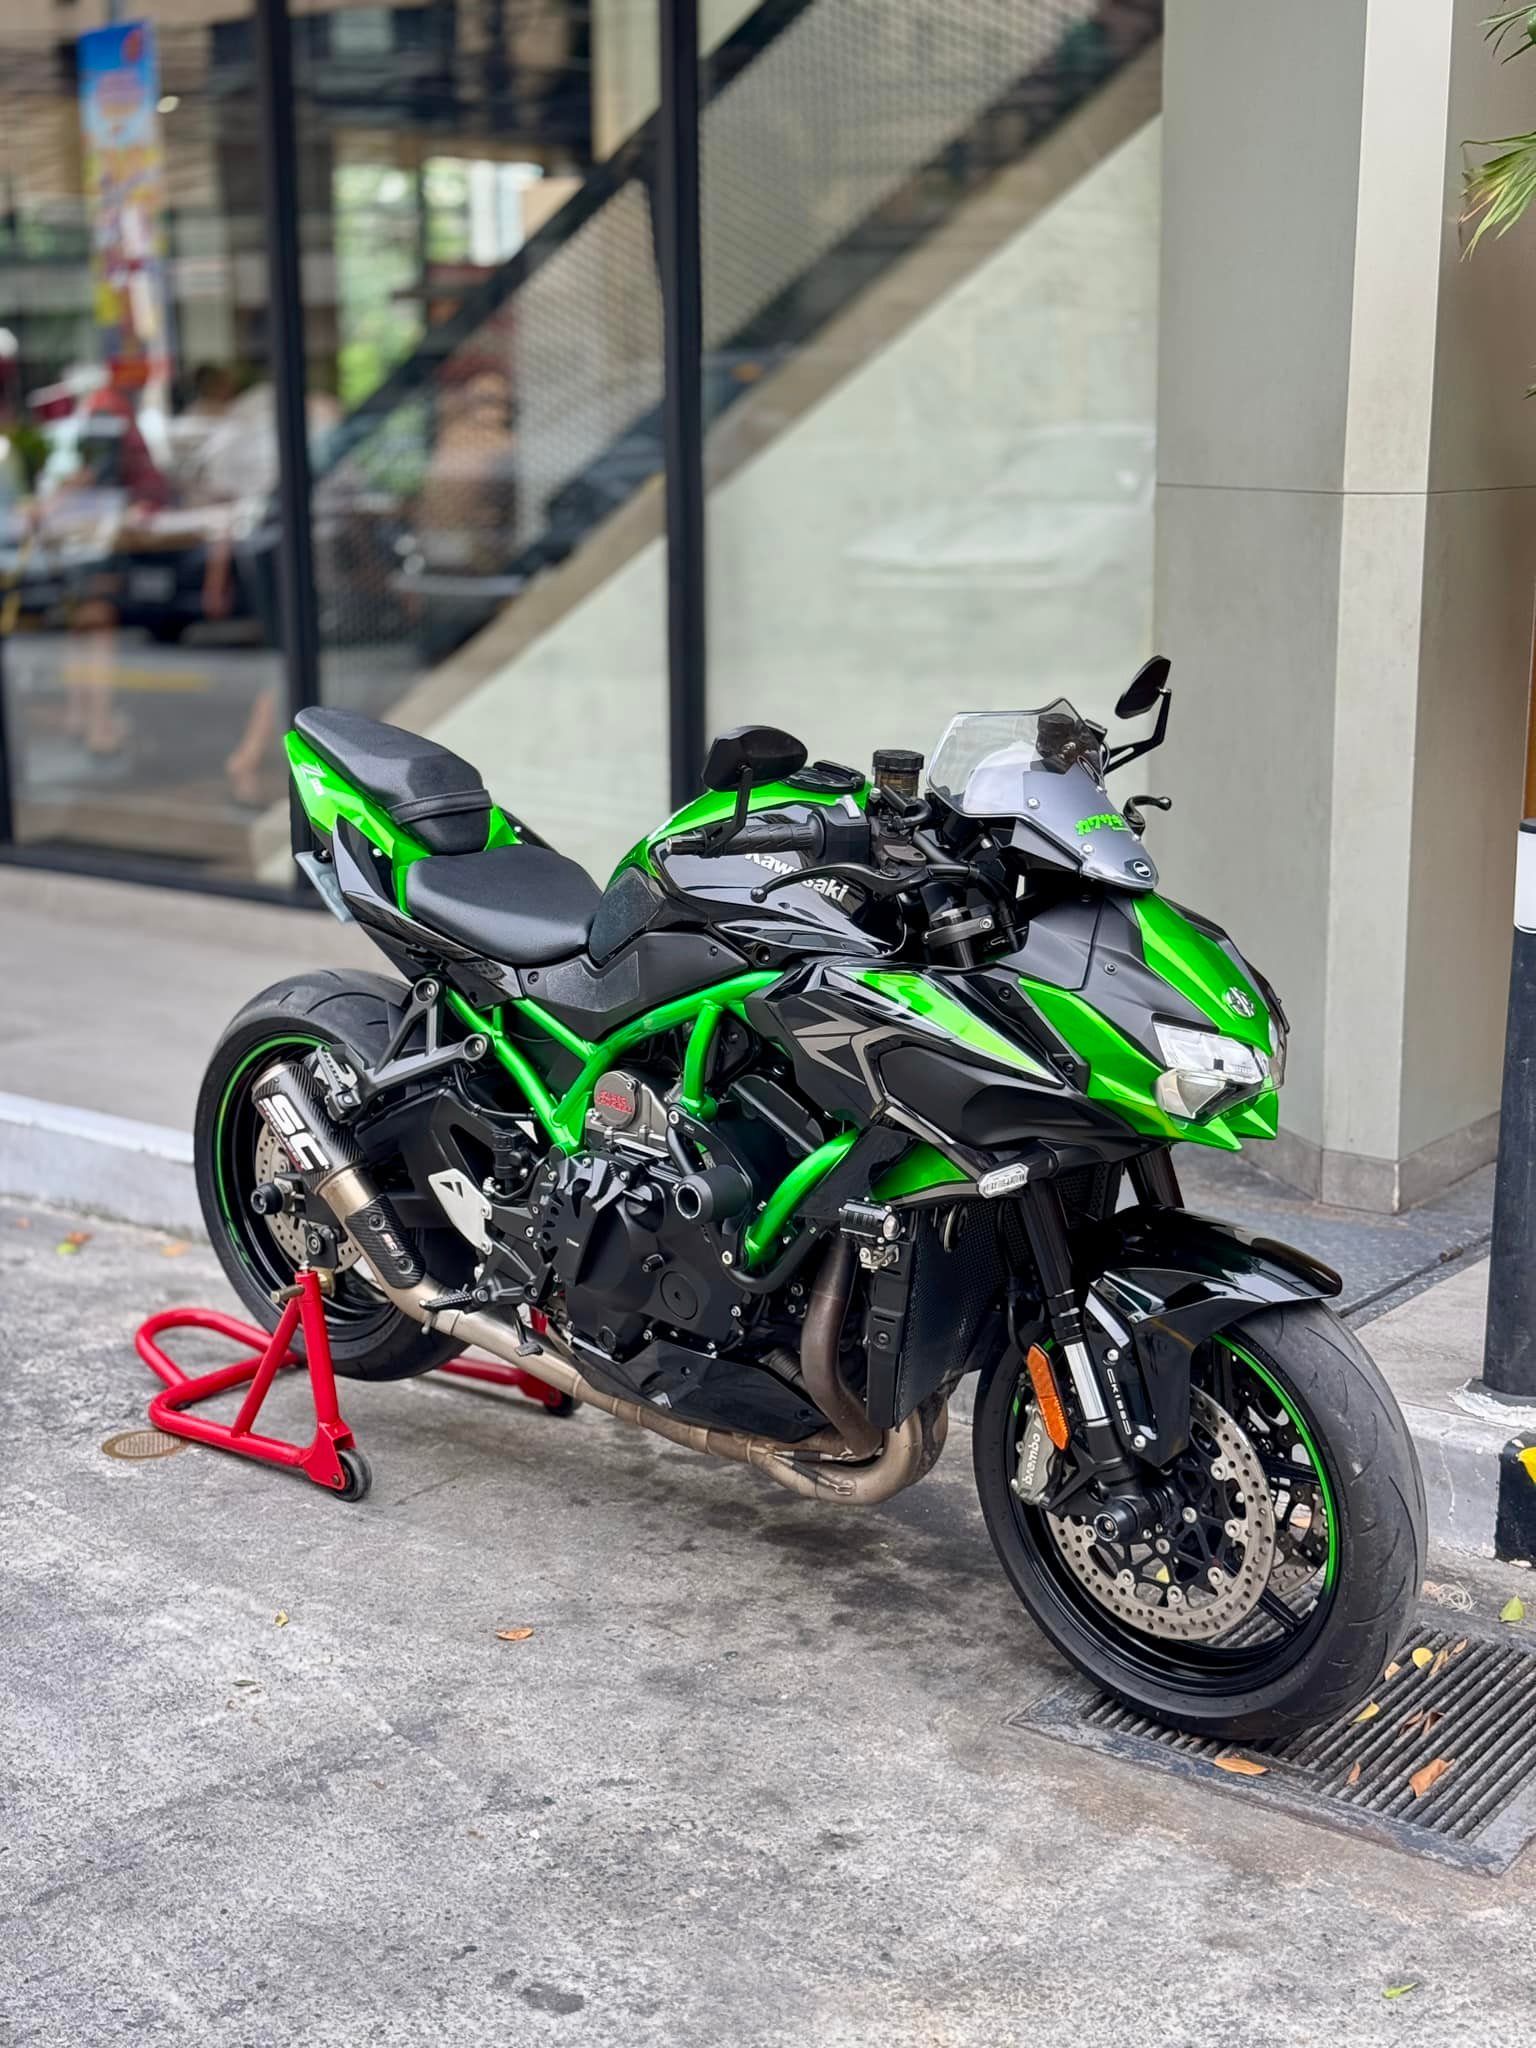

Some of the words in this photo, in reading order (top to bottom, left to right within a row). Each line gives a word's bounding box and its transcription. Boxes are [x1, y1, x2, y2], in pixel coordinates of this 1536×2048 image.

[745, 853, 849, 902] awsaki
[259, 1094, 331, 1170] SC
[1022, 1433, 1040, 1485] brembo
